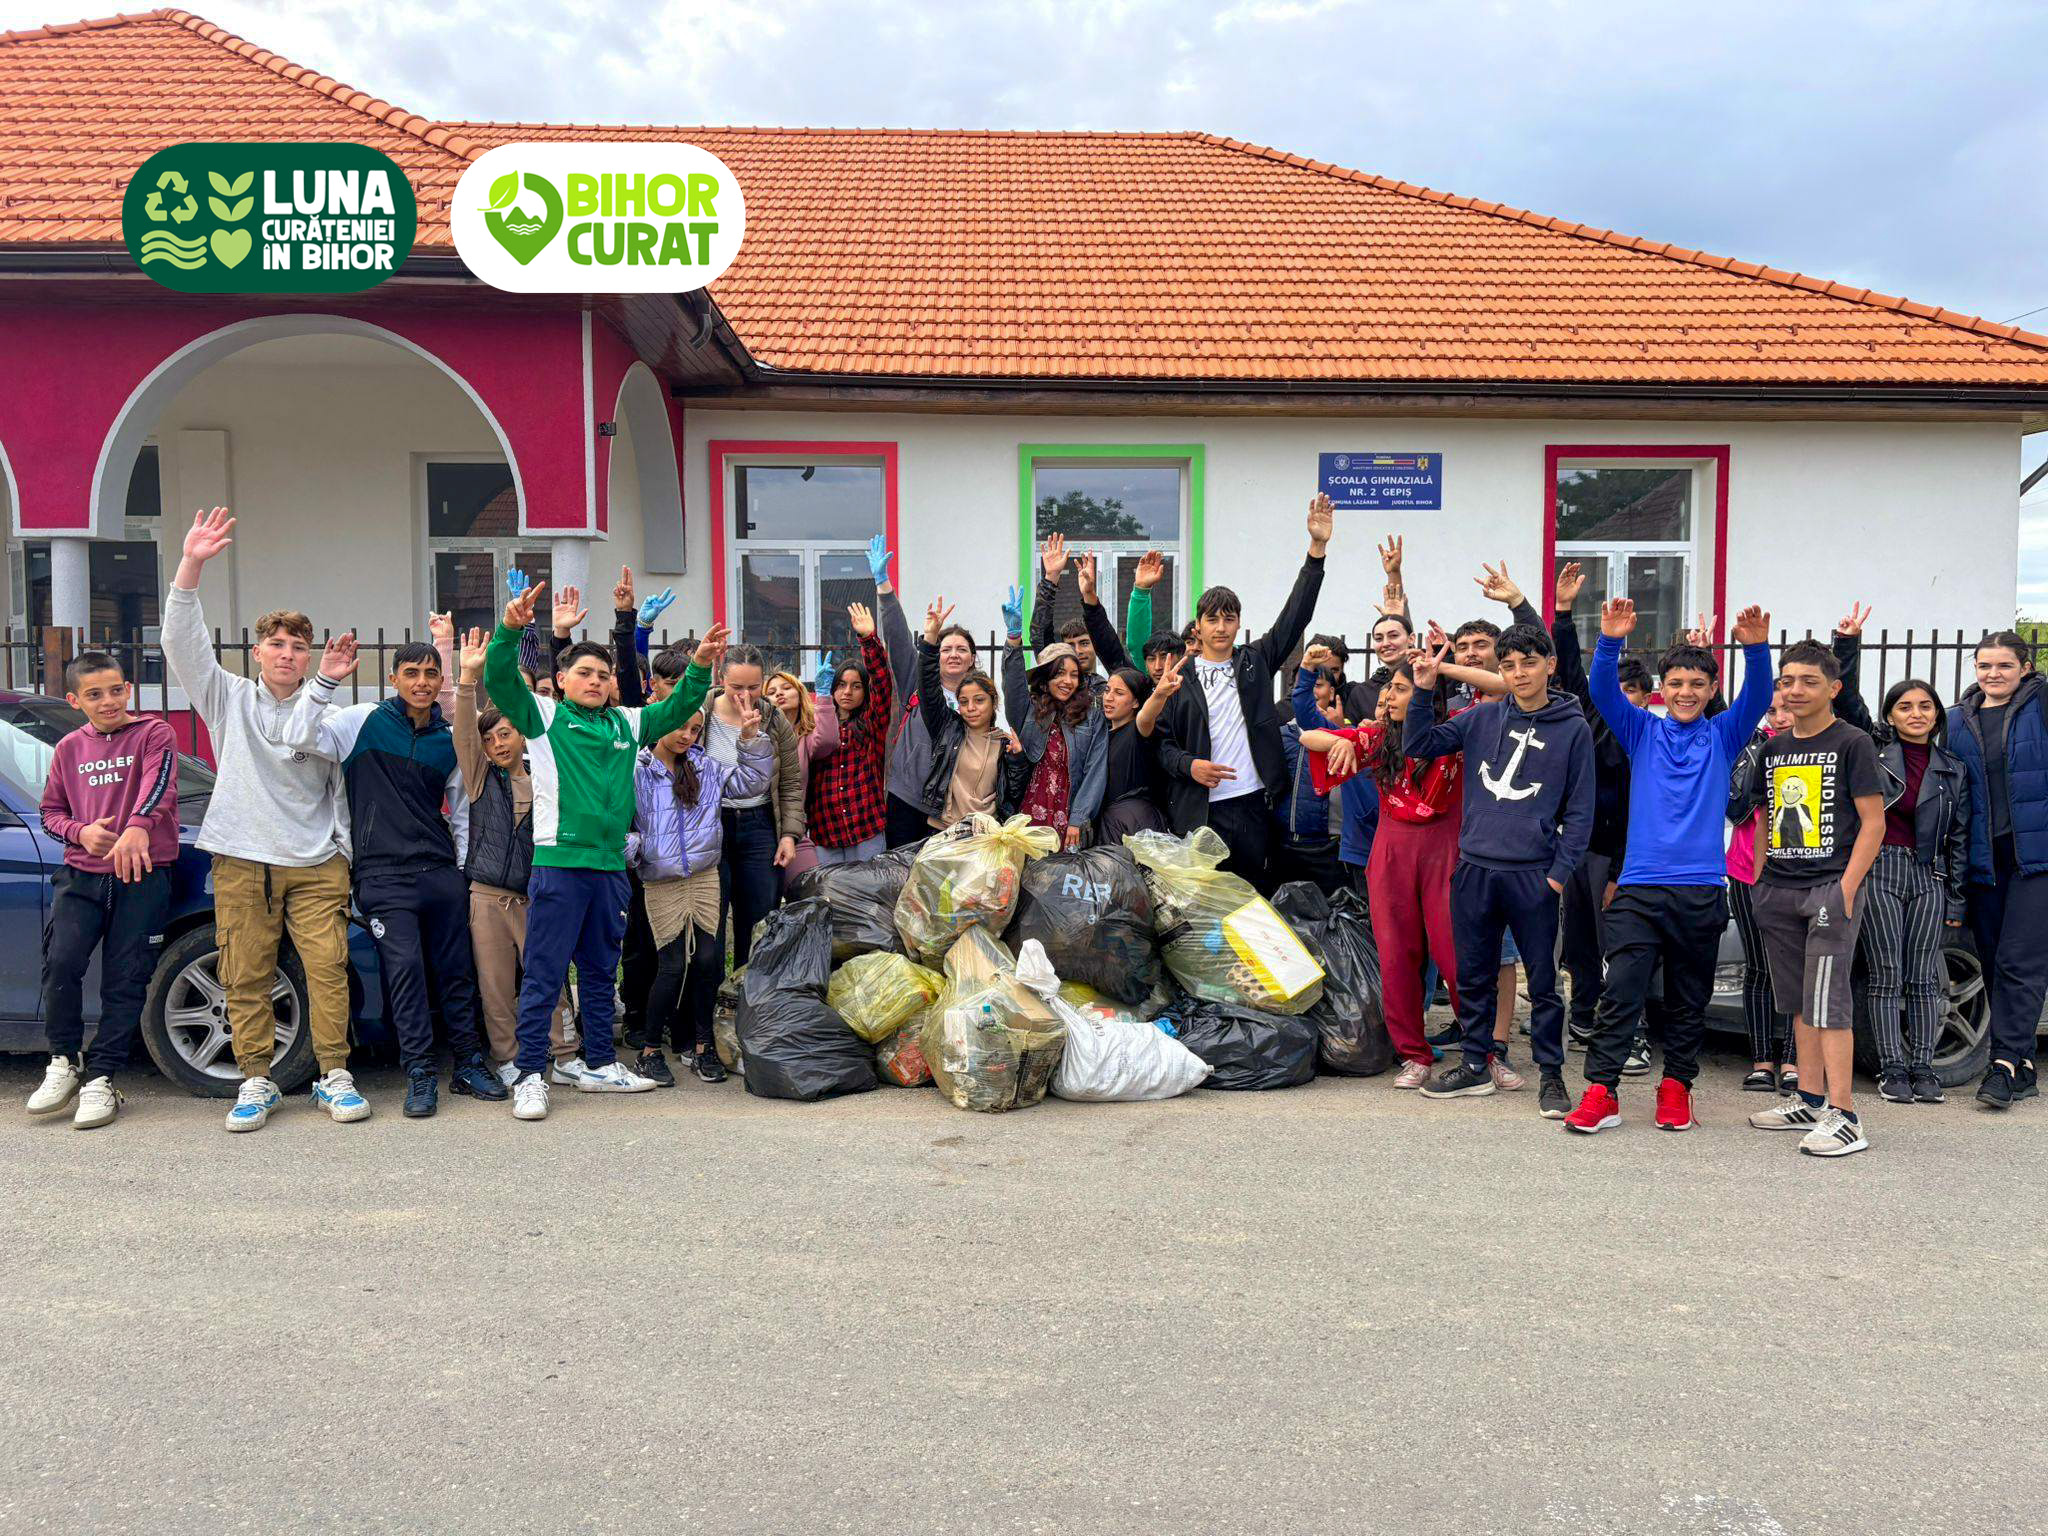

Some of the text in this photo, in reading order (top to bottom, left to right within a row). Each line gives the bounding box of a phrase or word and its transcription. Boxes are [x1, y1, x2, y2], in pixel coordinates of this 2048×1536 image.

[1328, 475, 1433, 486] ȘCOALA GIMNAZIALĂ
[1349, 488, 1412, 498] NR. 2 GEPIȘ
[1765, 752, 1838, 768] UNLIMITED
[88, 771, 123, 787] GIRL
[1821, 764, 1837, 847] ENDLESS
